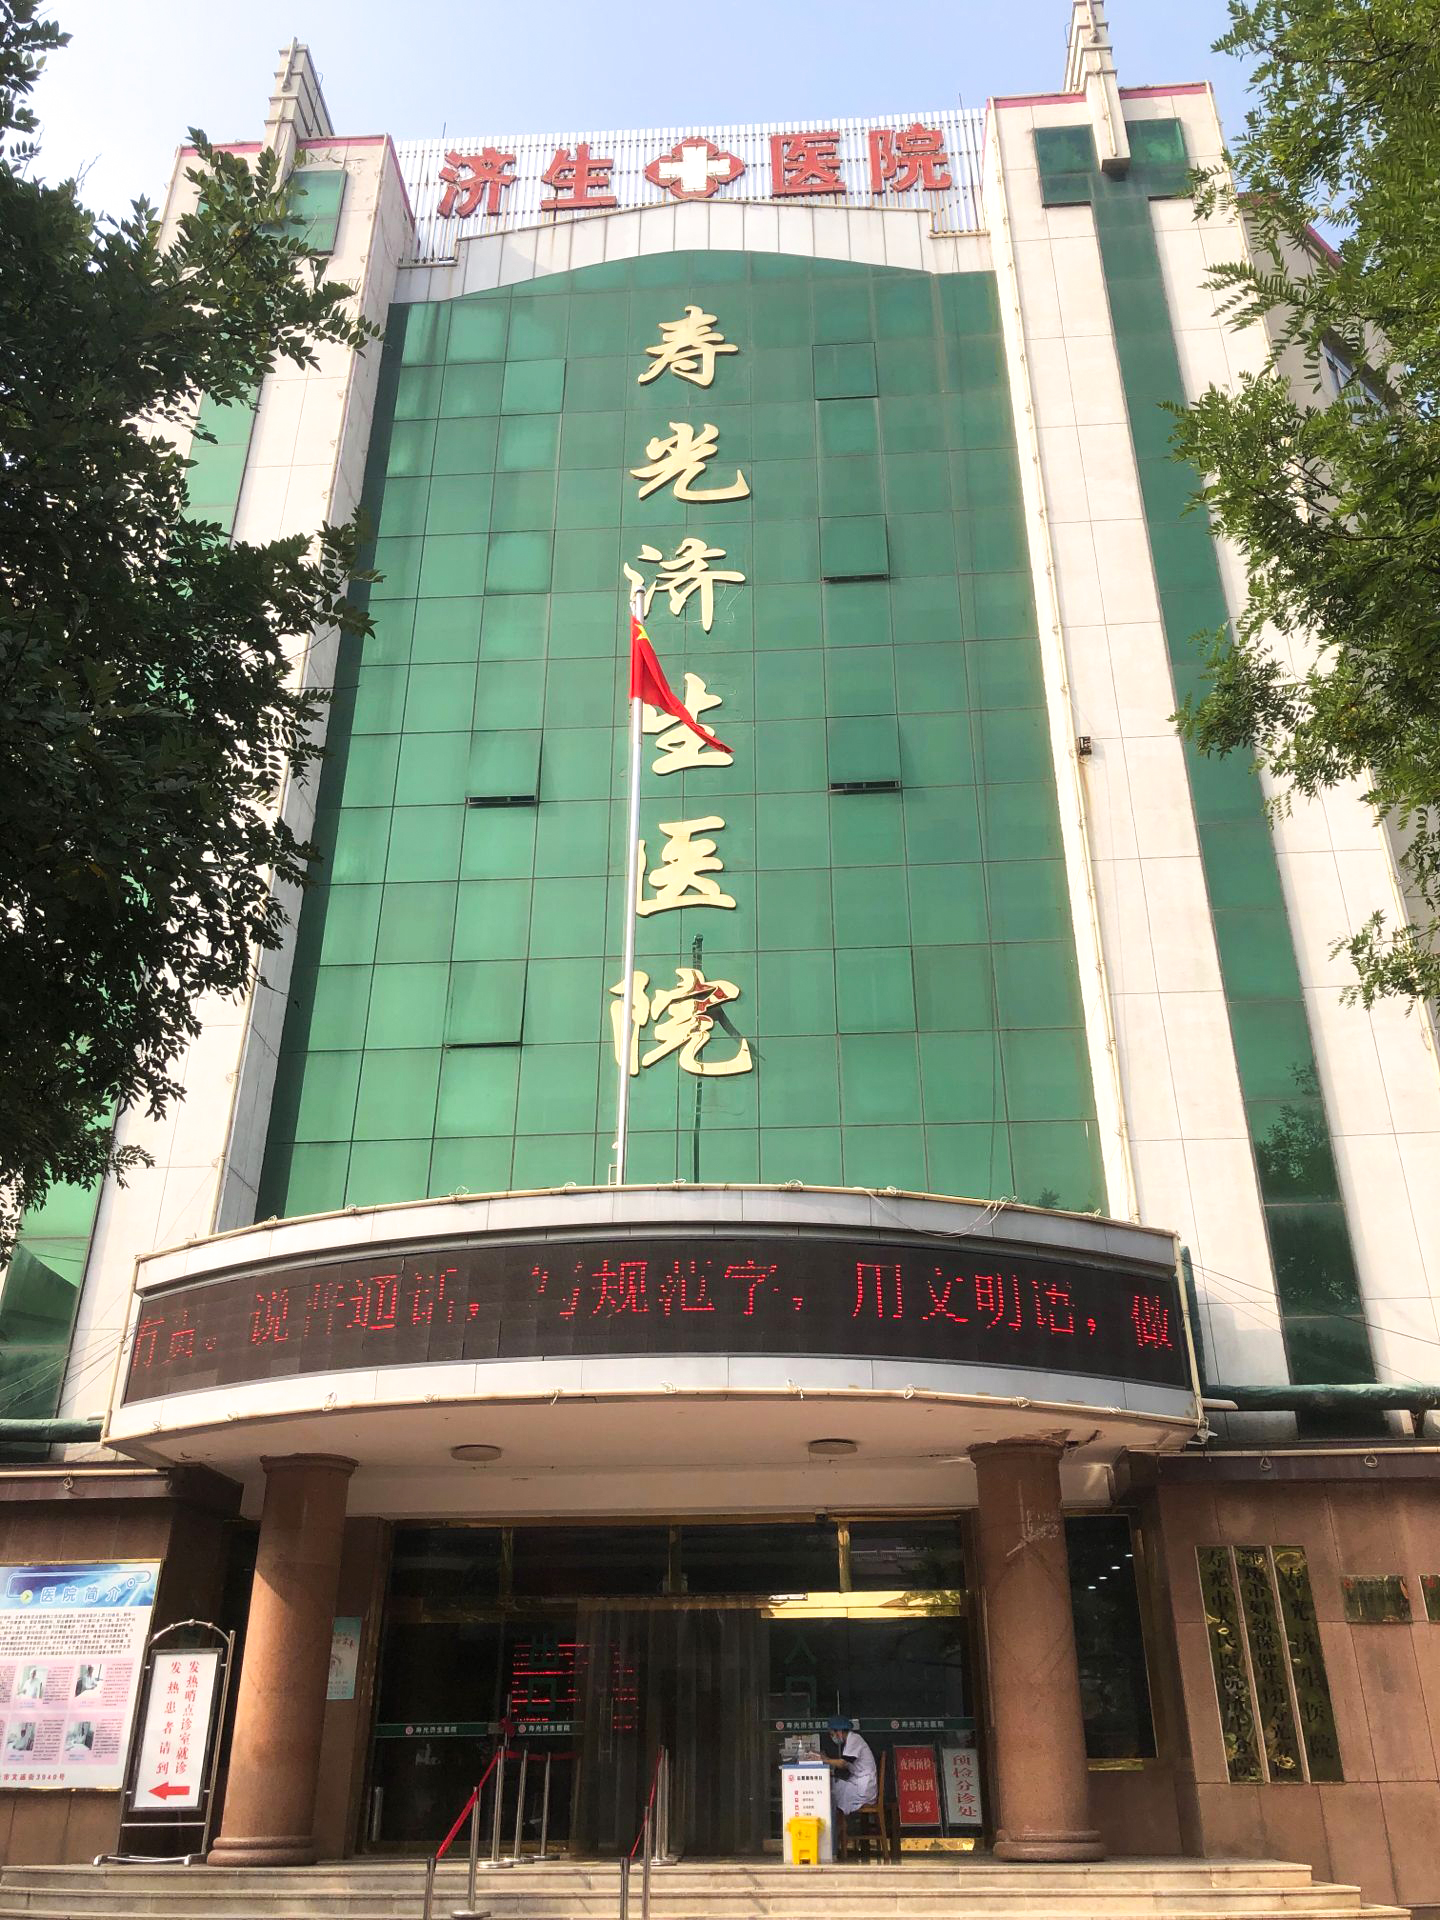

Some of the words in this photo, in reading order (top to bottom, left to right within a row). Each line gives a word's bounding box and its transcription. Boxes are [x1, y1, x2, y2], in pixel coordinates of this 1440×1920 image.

[437, 145, 618, 218] 济生
[769, 122, 953, 197] 医院
[608, 304, 756, 1077] 寿光济生医院
[40, 1585, 121, 1603] 医院简介
[155, 1661, 182, 1774] 发热患者请到
[175, 1660, 200, 1774] 发热哨点诊室就诊
[952, 1754, 977, 1818] 预检分诊处
